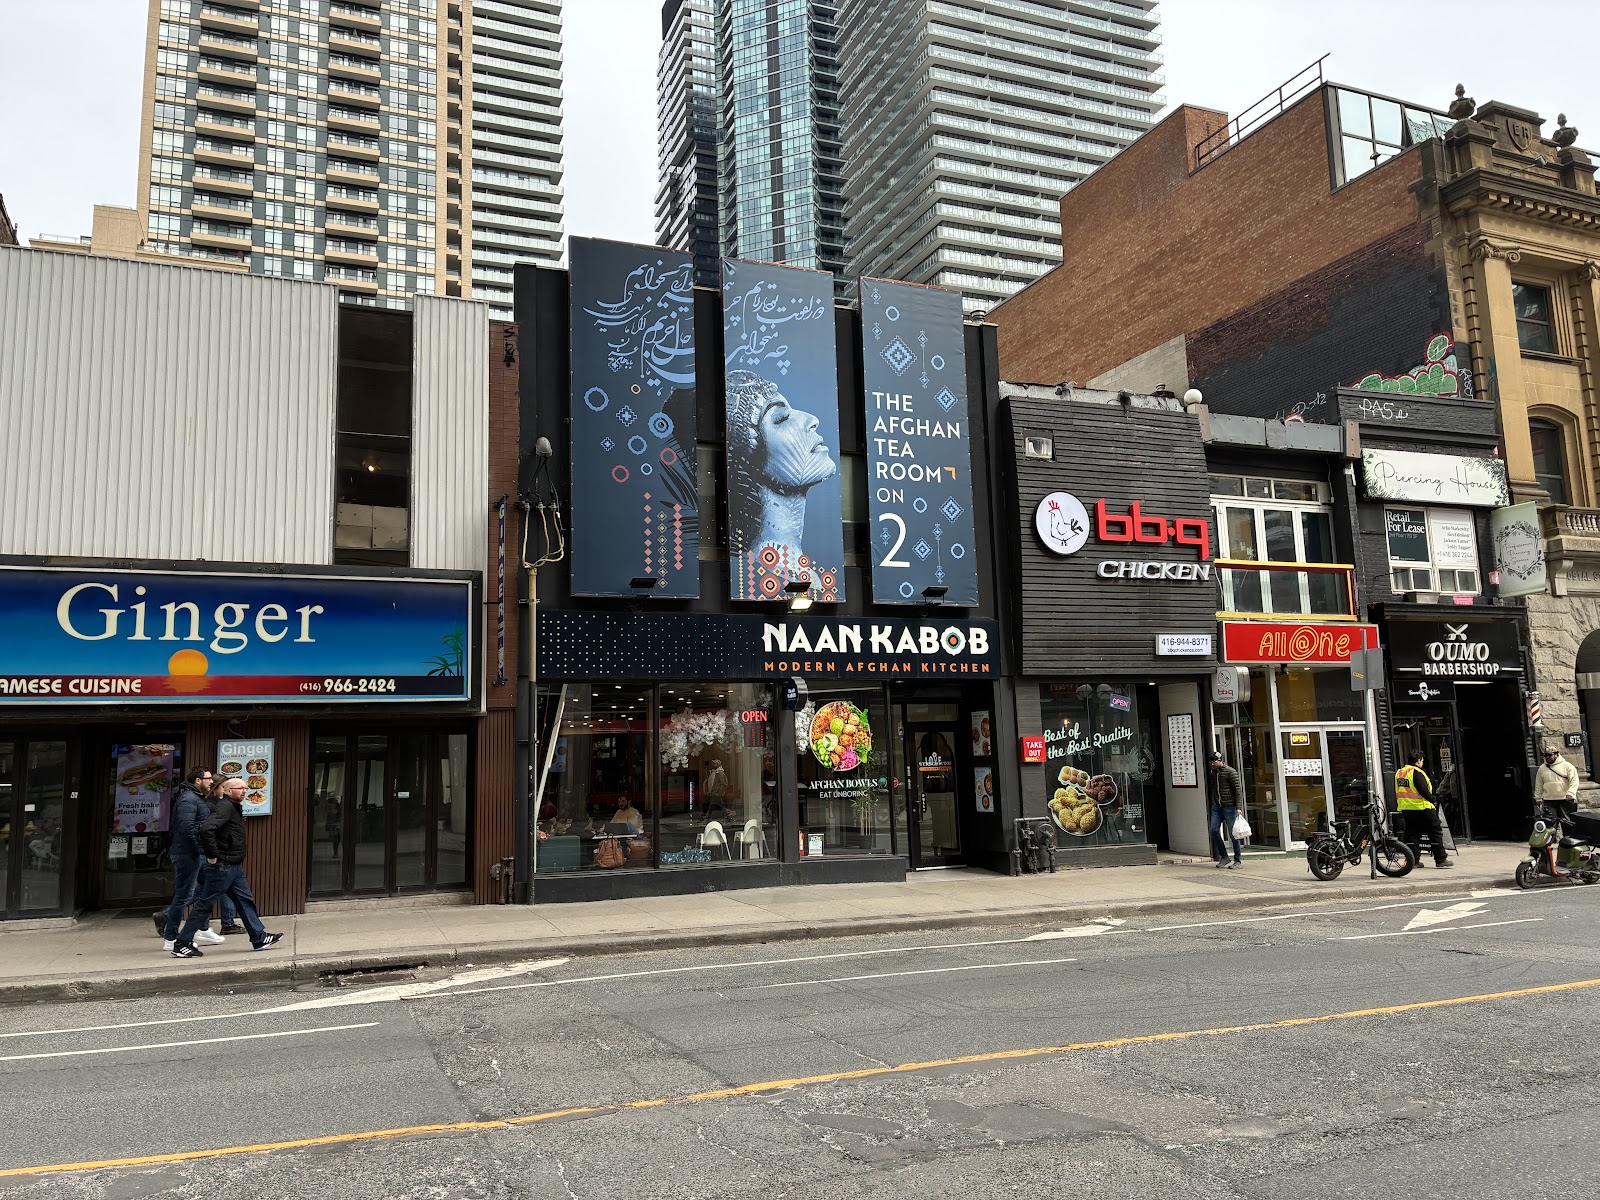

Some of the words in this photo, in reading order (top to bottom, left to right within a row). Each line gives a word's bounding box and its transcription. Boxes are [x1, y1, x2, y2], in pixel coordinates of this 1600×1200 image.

[872, 391, 914, 412] THE
[873, 415, 961, 439] AFGHAN
[873, 438, 915, 458] TEA
[876, 461, 942, 483] ROOM
[1374, 460, 1444, 496] Piercing
[1450, 466, 1497, 496] House
[876, 488, 905, 504] ON
[1386, 510, 1411, 523] Retail
[1387, 521, 1402, 532] For
[1402, 522, 1426, 534] Lease
[879, 512, 911, 568] 2
[1097, 559, 1210, 581] CHICKEN
[56, 582, 324, 654] Ginger
[761, 623, 863, 653] NAAN
[869, 625, 989, 656] KABOB
[1161, 637, 1208, 646] 416-944-8371
[1427, 641, 1490, 661] OUMO
[764, 662, 835, 672] MODERN
[846, 662, 912, 672] AFGHAN
[921, 663, 990, 673] KITCHEN
[1423, 662, 1500, 675] BARBERSHOP
[69, 678, 141, 694] CUISINE
[300, 682, 321, 693] (416)
[324, 678, 396, 693] 966-2424
[1112, 698, 1129, 708] OPEN
[741, 710, 767, 722] OPEN
[1043, 729, 1067, 743] Best
[1068, 722, 1081, 739] of
[1292, 735, 1308, 743] OPEN
[221, 743, 270, 756] Ginger
[1047, 746, 1066, 760] the
[1067, 737, 1092, 755] Best
[1093, 726, 1133, 748] Quality
[1028, 749, 1041, 757] OUT
[809, 779, 845, 790] AFGHAN
[846, 778, 878, 789] BOWLS
[819, 790, 832, 798] EAT
[833, 789, 869, 798] UNBORING
